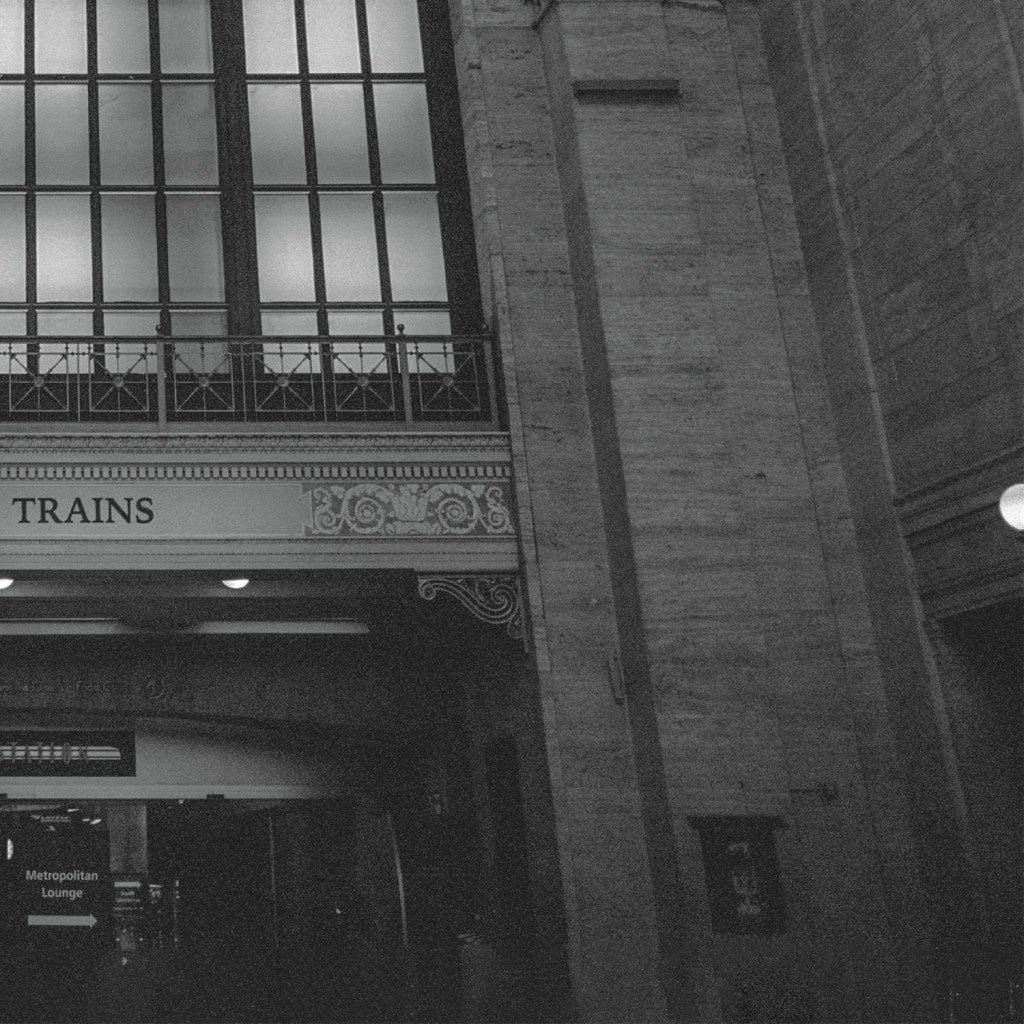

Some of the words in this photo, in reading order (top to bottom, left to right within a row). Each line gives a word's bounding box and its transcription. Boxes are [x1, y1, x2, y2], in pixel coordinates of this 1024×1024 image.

[12, 497, 155, 524] TRAINS
[25, 869, 98, 883] Metropolitan
[41, 887, 83, 901] Lounge
